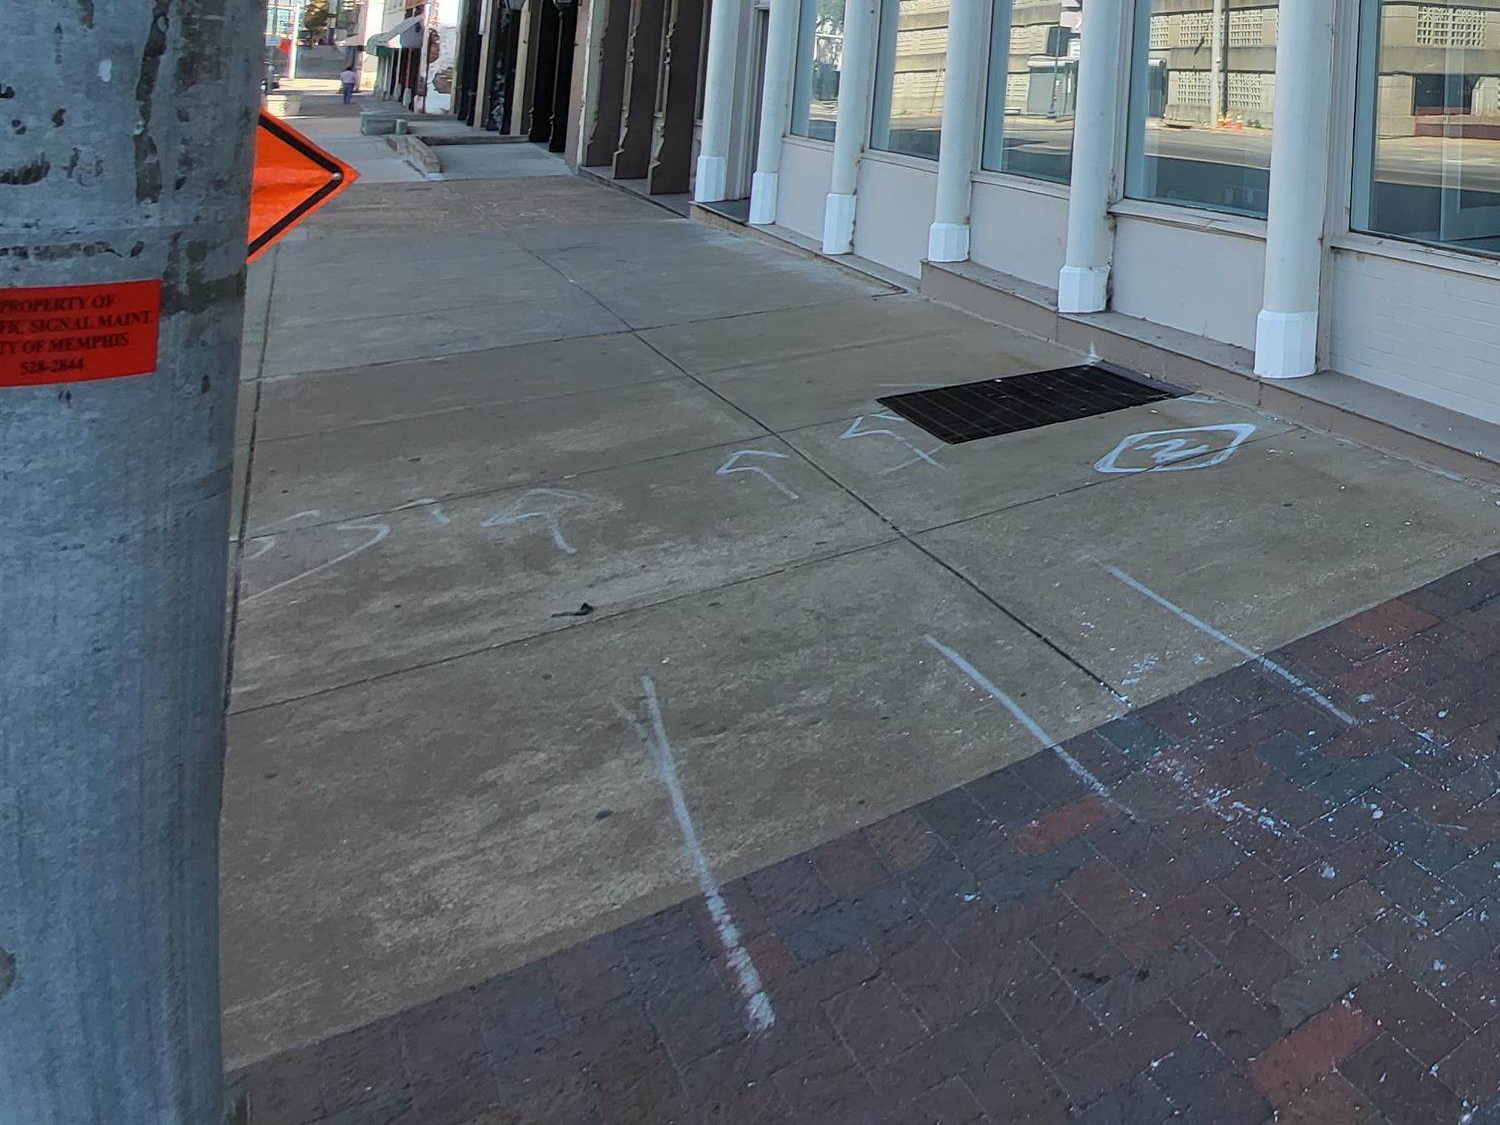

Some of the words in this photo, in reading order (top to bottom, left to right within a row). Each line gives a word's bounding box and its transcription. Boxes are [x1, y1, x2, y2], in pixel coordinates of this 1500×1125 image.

[92, 295, 114, 309] OF
[30, 316, 94, 333] SIGNAL
[22, 339, 45, 354] OF
[50, 333, 129, 351] MEMPHIS
